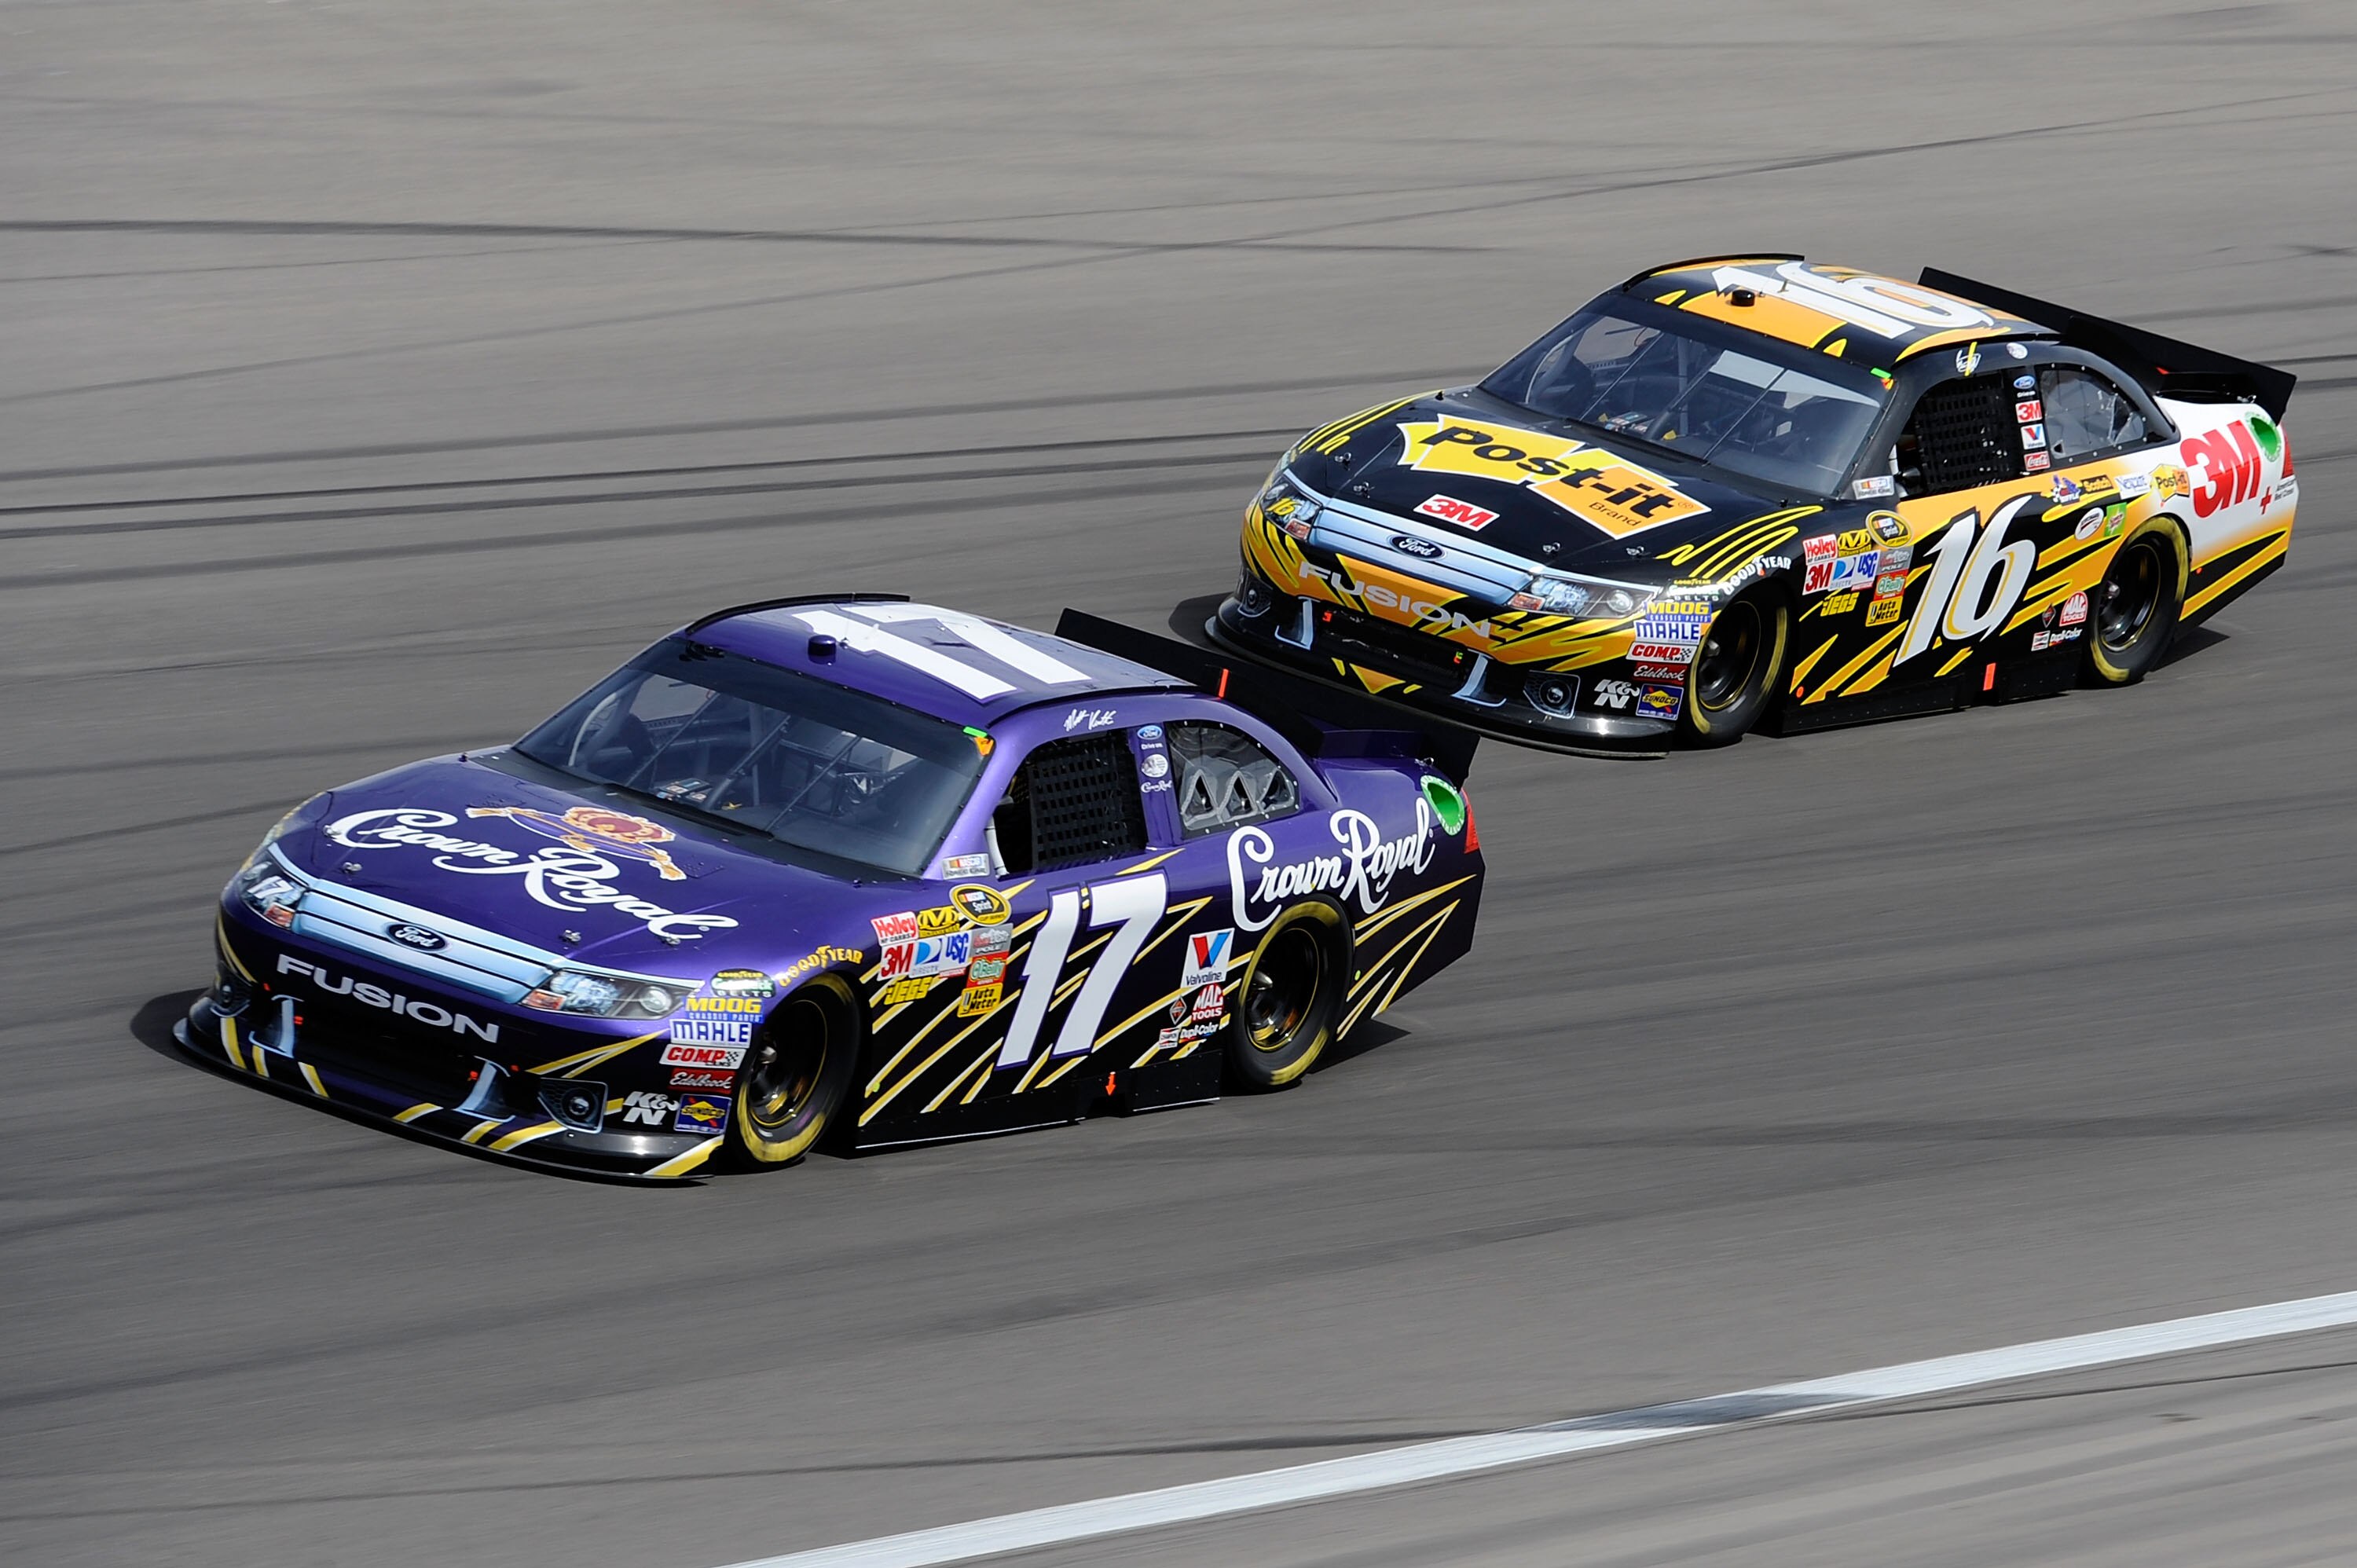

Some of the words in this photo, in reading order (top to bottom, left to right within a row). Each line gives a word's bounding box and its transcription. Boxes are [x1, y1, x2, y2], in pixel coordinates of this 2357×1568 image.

[1711, 262, 1994, 339] 16
[2018, 403, 2042, 421] 3M
[1420, 426, 1677, 518] Post-it
[2180, 419, 2261, 518] 3M
[2084, 478, 2113, 493] Scotch
[2156, 473, 2186, 489] Post-it
[1266, 497, 1296, 516] 16
[1422, 498, 1494, 528] 3M
[1589, 501, 1641, 528] Brand
[1398, 537, 1437, 557] Ford
[1805, 538, 1836, 559] Holley
[1723, 555, 1792, 595] GOODYEAR
[1857, 551, 1879, 579] USG
[1805, 562, 1834, 592] 3M
[1893, 494, 2036, 668] 16
[1298, 560, 1492, 639] FUSION
[1647, 602, 1710, 615] MOOG
[1879, 600, 1897, 611] Auto
[1636, 622, 1700, 640] MAHLE
[792, 605, 1093, 702] 17
[1631, 644, 1681, 658] COMP
[1633, 665, 1686, 681] Edelbrock
[1643, 694, 1678, 705] SUNOCO
[330, 808, 519, 864] Crown
[433, 847, 739, 940] Royal
[1227, 826, 1346, 932] Crown
[1329, 797, 1436, 914] Royal
[247, 876, 295, 899] 17
[394, 925, 438, 948] Ford
[874, 917, 916, 938] Holley
[945, 932, 970, 964] USG
[975, 944, 1003, 954] POLE
[778, 945, 863, 987] GOODYEAR
[881, 943, 914, 977] 3M
[995, 872, 1168, 1068] 17
[1186, 971, 1223, 986] Valvoline
[277, 954, 500, 1044] FUSION
[717, 989, 772, 999] BELTS
[884, 976, 931, 1006] JEGS
[973, 988, 995, 1000] Auto
[1192, 983, 1224, 1011] MAC
[685, 997, 763, 1013] MOOG
[970, 997, 997, 1009] Meter
[1191, 1007, 1223, 1020] TOOLS
[673, 1021, 749, 1043] MAHLE
[1178, 1022, 1219, 1039] Dupli-Color
[666, 1046, 727, 1063] COMP
[669, 1071, 734, 1089] Edelbrock
